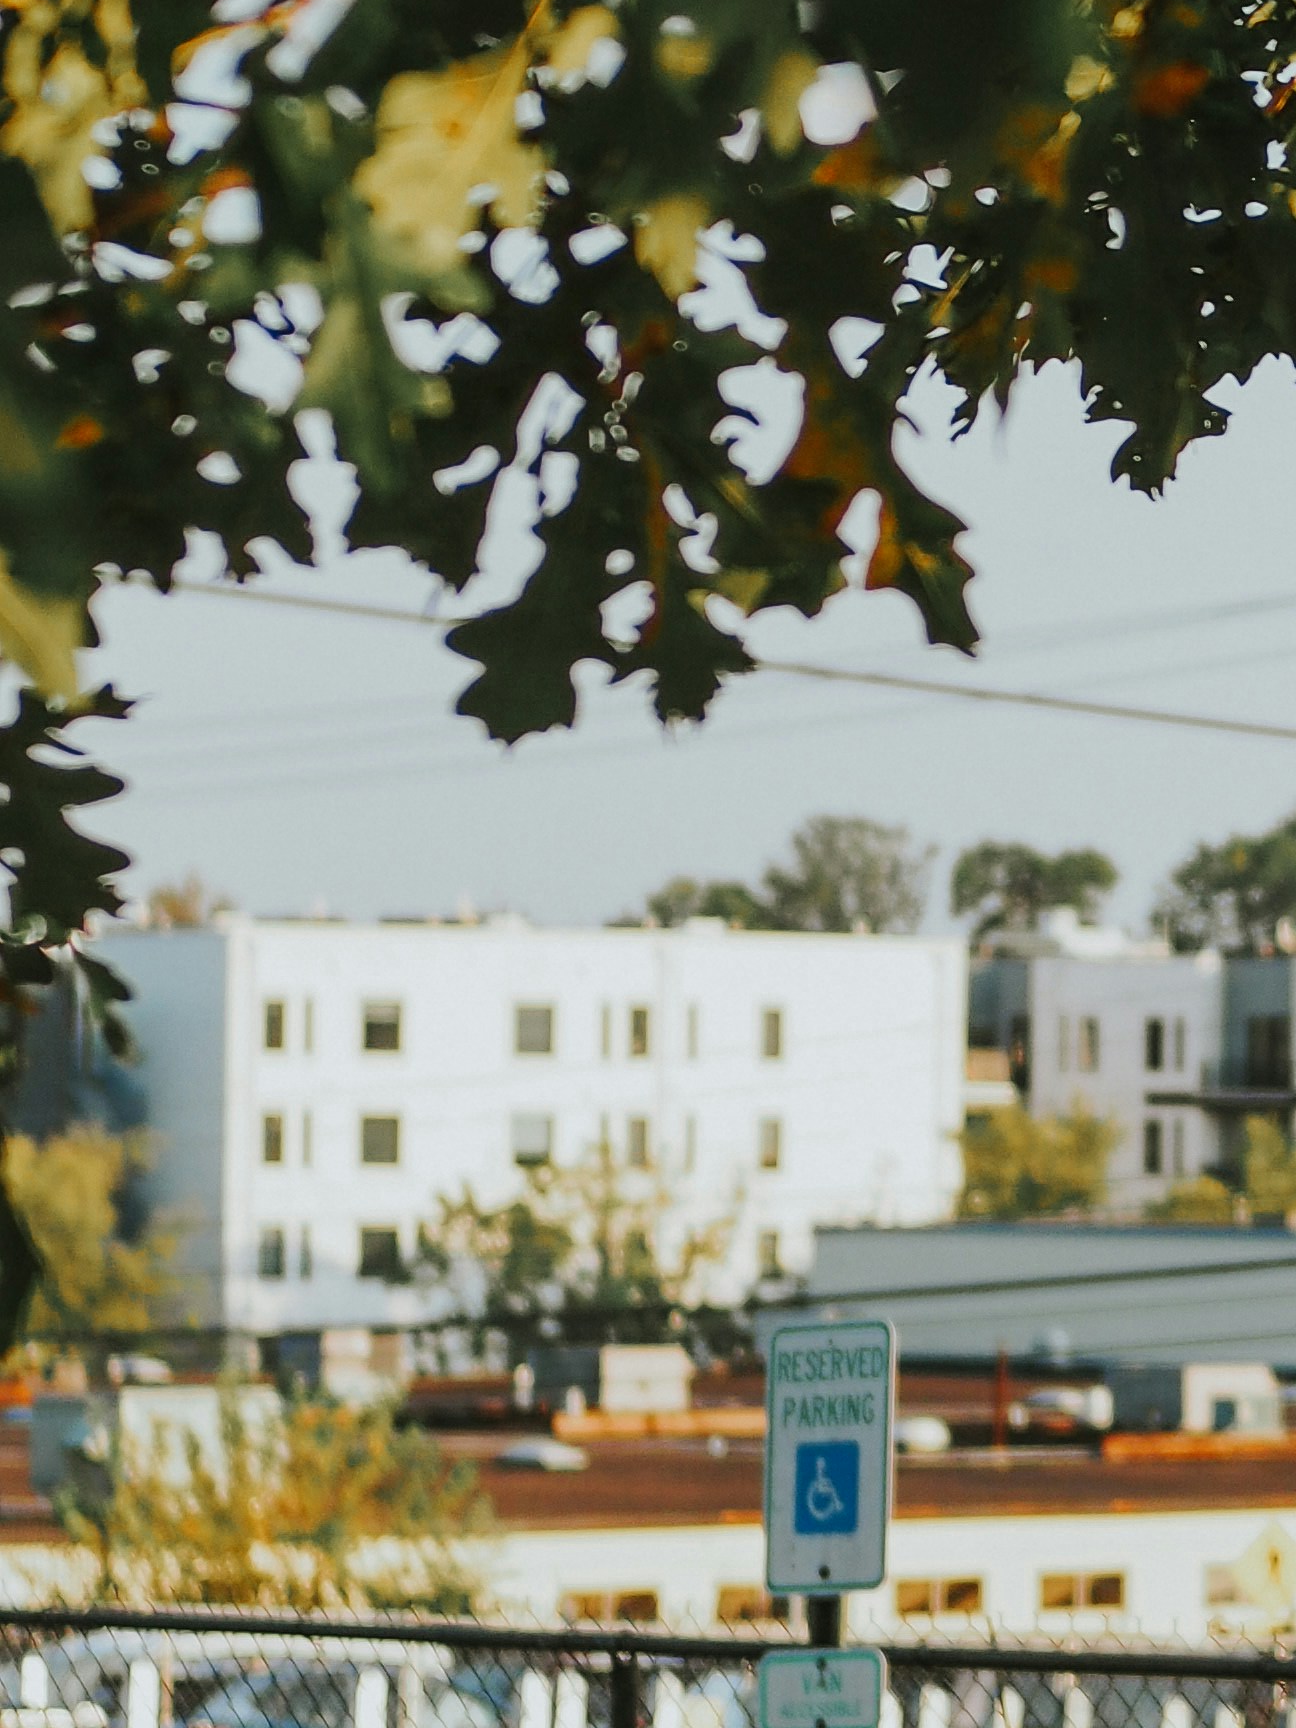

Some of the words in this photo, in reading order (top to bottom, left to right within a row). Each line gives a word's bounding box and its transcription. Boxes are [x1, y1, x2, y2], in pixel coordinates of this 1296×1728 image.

[778, 1346, 884, 1381] RESERVED
[783, 1392, 875, 1427] PARKING
[802, 1671, 843, 1695] VAN
